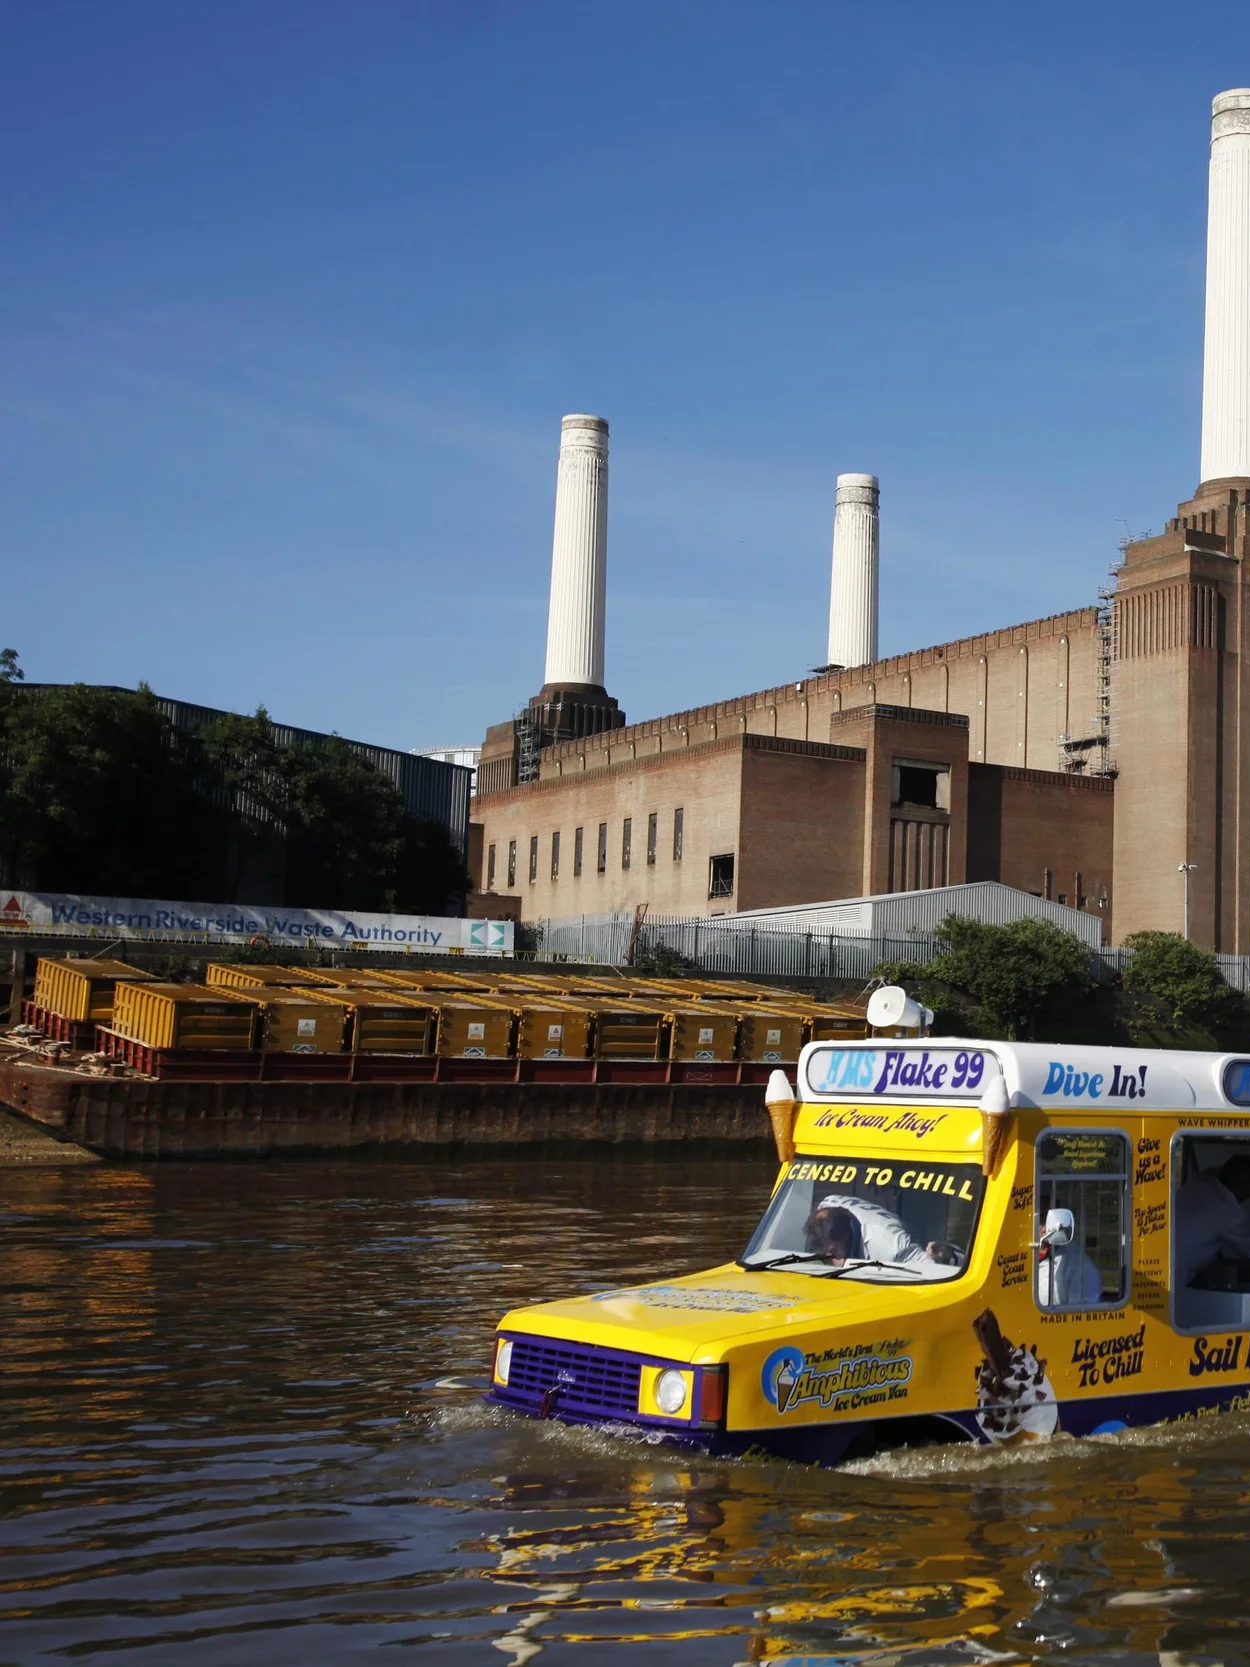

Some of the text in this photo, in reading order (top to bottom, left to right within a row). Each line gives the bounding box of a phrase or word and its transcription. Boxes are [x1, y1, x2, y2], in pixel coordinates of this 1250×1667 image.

[51, 903, 442, 945] Western Riverside Waste Authority
[873, 1052, 948, 1093] Flake
[951, 1052, 985, 1089] 99
[1042, 1062, 1148, 1099] Dive In!
[814, 1109, 948, 1138] Ice Cream Ahoy!
[1178, 1118, 1204, 1127] WAVE
[1208, 1119, 1249, 1128] WHIPPER
[1137, 1138, 1161, 1154] Give
[1138, 1154, 1160, 1169] us a
[864, 1167, 893, 1186] TO
[900, 1170, 974, 1201] CHILL
[1135, 1164, 1166, 1185] Wave!
[1011, 1184, 1034, 1198] Super
[1013, 1195, 1033, 1210] Soft!
[1134, 1202, 1167, 1220] Top Speed
[1143, 1213, 1164, 1226] Flakes
[1138, 1222, 1167, 1238] Per Hour
[997, 1251, 1028, 1267] Coast to
[1002, 1263, 1024, 1277] Coast
[1001, 1274, 1028, 1288] Service
[1041, 1311, 1125, 1324] MADE IN BRITAIN
[1071, 1324, 1146, 1363] Licensed
[805, 1353, 822, 1365] The
[824, 1349, 853, 1361] World's
[854, 1344, 873, 1357] First
[1189, 1336, 1242, 1376] Sail
[1079, 1350, 1144, 1388] To Chill
[788, 1358, 911, 1405] Amphibious
[833, 1384, 908, 1412] Ice Cream Van
